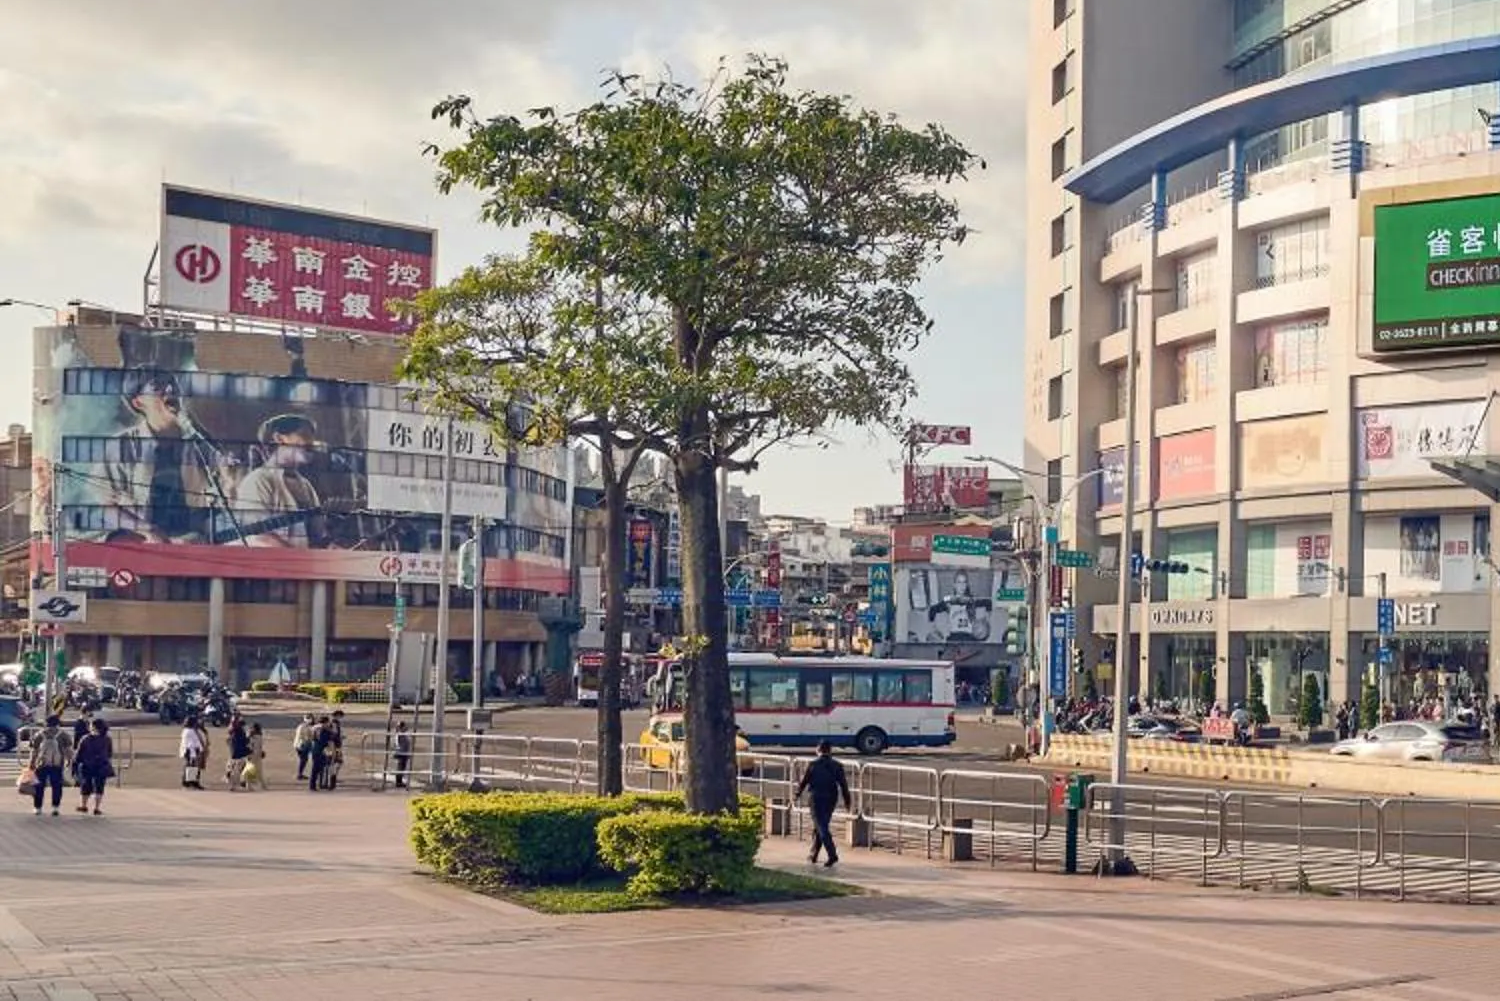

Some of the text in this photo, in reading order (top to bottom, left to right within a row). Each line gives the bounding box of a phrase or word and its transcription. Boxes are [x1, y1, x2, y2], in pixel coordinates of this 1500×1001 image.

[241, 234, 422, 289] 華南金控
[1393, 601, 1439, 626] NET
